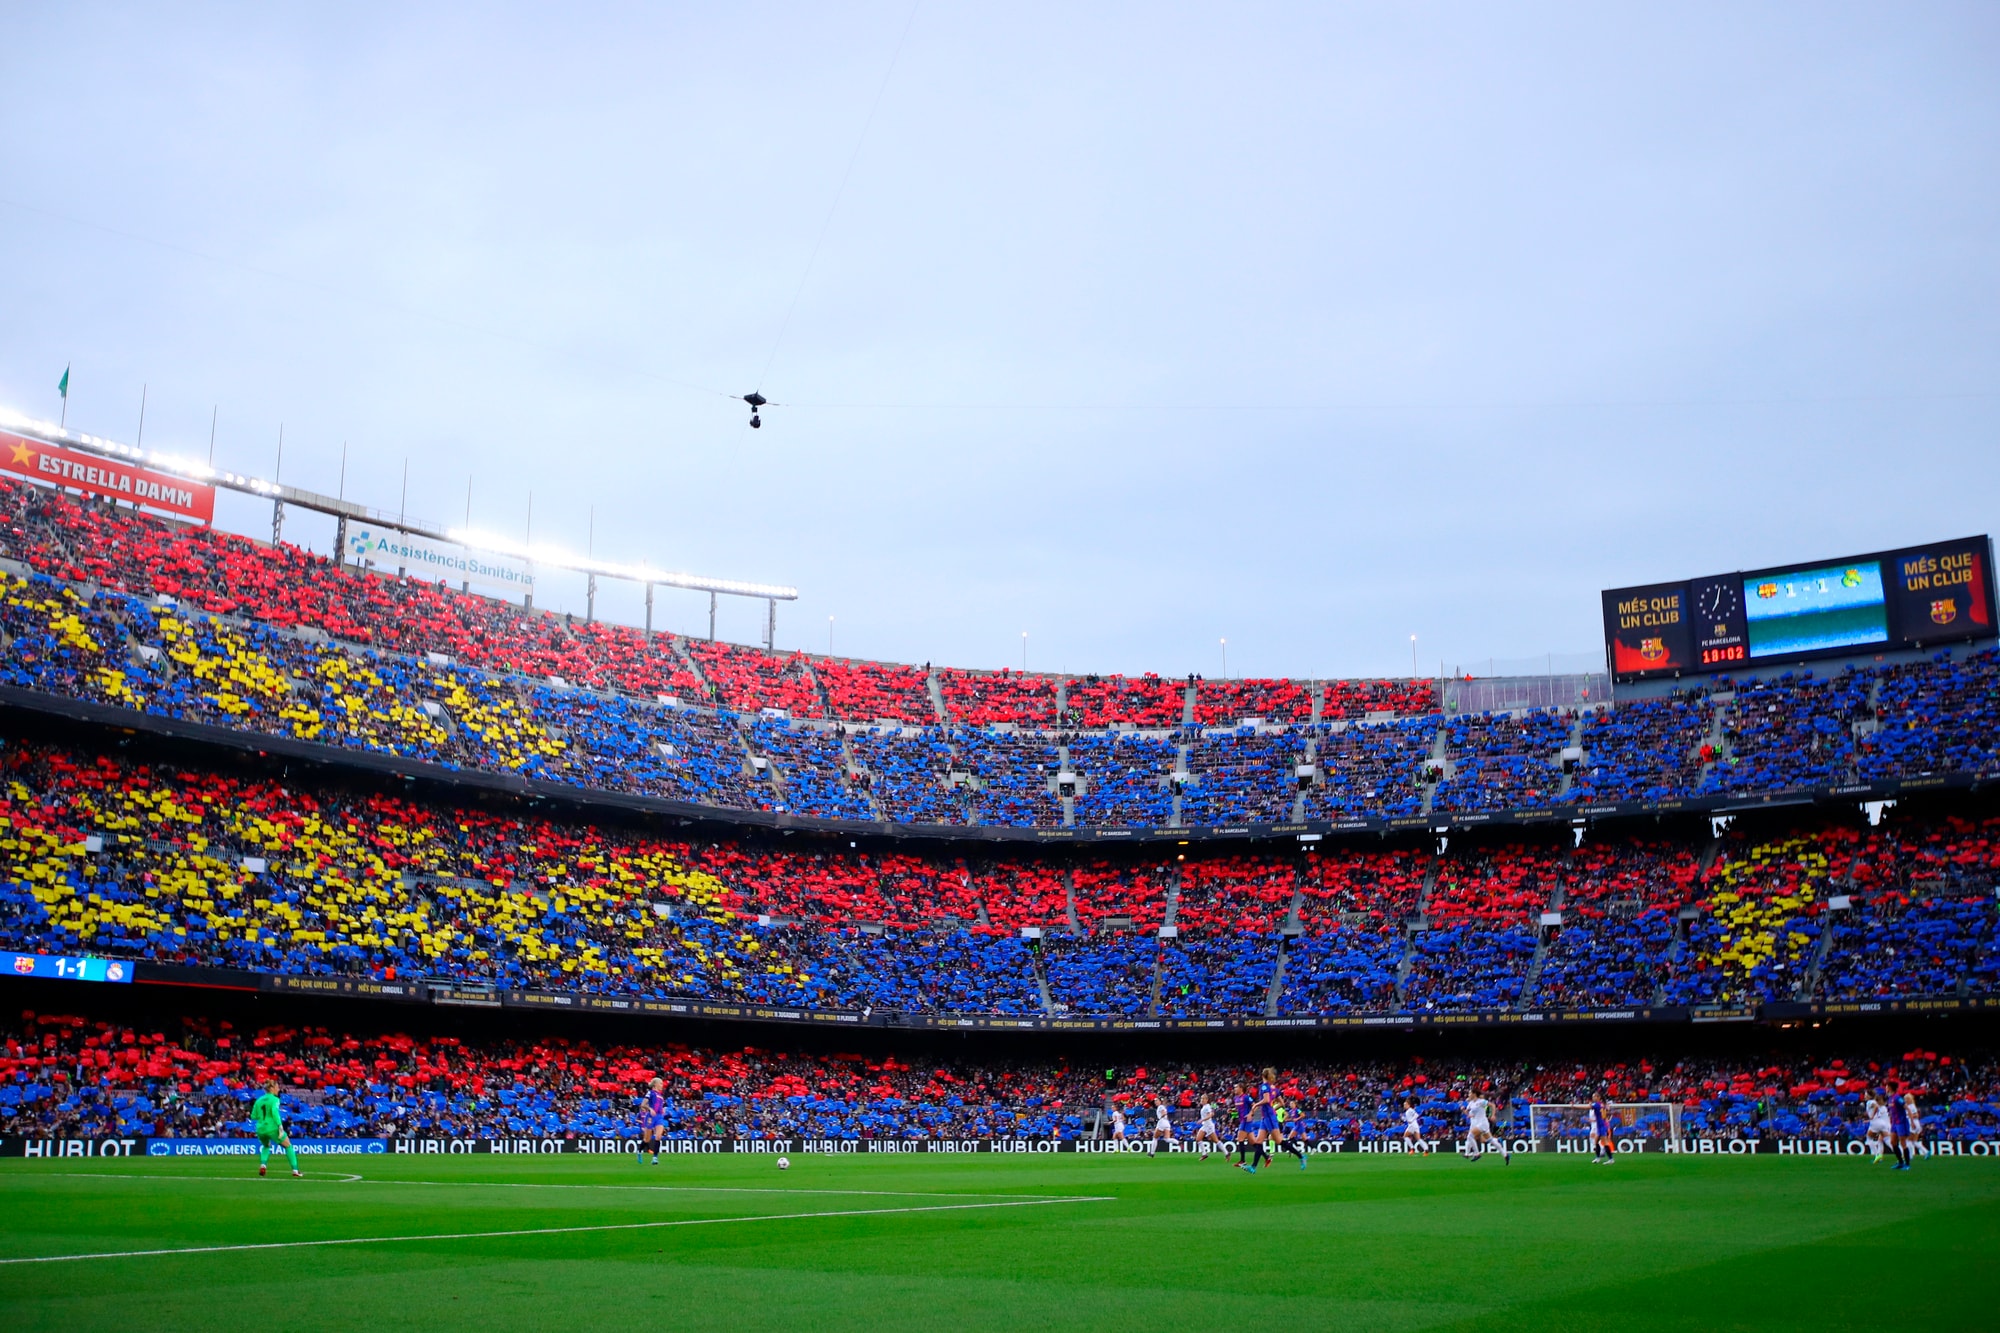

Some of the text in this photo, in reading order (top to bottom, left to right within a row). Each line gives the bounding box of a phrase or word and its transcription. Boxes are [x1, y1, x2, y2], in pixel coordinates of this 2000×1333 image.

[38, 454, 193, 508] ESTRELLA DAMM
[377, 538, 533, 585] Assistència Sanitària
[1904, 552, 1972, 576] MÉS QUE
[1785, 583, 1796, 598] 1
[1816, 578, 1829, 594] 1
[1907, 569, 1973, 591] UN CLUB
[1618, 596, 1679, 614] MÉS QUE
[1621, 611, 1679, 629] UN CLUB
[1709, 636, 1741, 646] BARCELONA
[1702, 645, 1744, 664] 18:02
[55, 957, 87, 978] 1-1
[24, 1139, 136, 1158] HUBLOT
[175, 1144, 202, 1156] UEFA
[205, 1144, 256, 1156] WOMEN'S
[325, 1144, 362, 1155] LEAGUE
[395, 1139, 476, 1154] HUBLOT
[490, 1139, 565, 1154] HUBLOT
[659, 1139, 723, 1153] HUBLOT
[733, 1139, 793, 1154] HUBLOT
[802, 1140, 859, 1153] HUBLOT
[868, 1140, 918, 1153] HUBLOT
[927, 1140, 980, 1153] HUBLOT
[990, 1140, 1062, 1153] HUBLOT
[1664, 1138, 1760, 1154] HUBLOT
